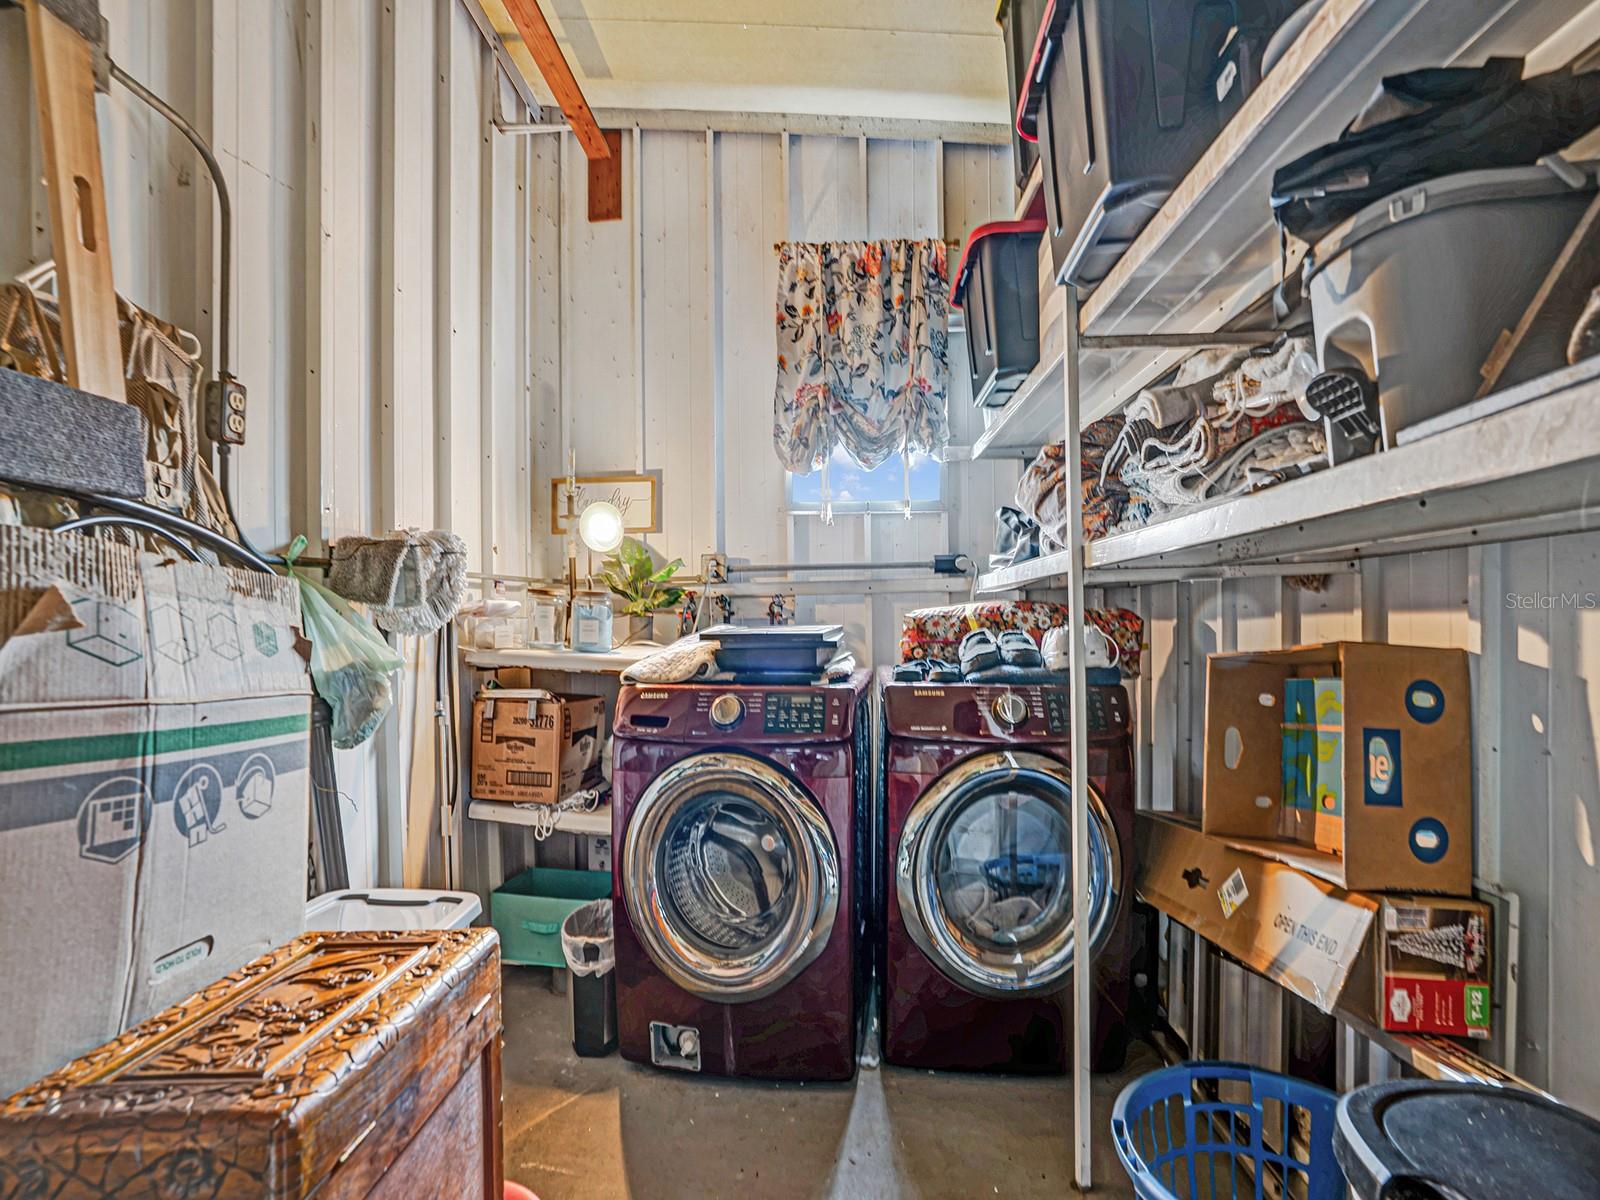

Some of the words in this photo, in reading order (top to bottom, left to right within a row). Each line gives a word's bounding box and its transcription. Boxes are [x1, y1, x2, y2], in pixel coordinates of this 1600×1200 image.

[640, 692, 669, 700] SAMSUNG
[914, 689, 945, 697] SAMSUNG
[1273, 912, 1296, 936] OPEN
[1296, 924, 1318, 946] THIS
[1316, 934, 1339, 955] END
